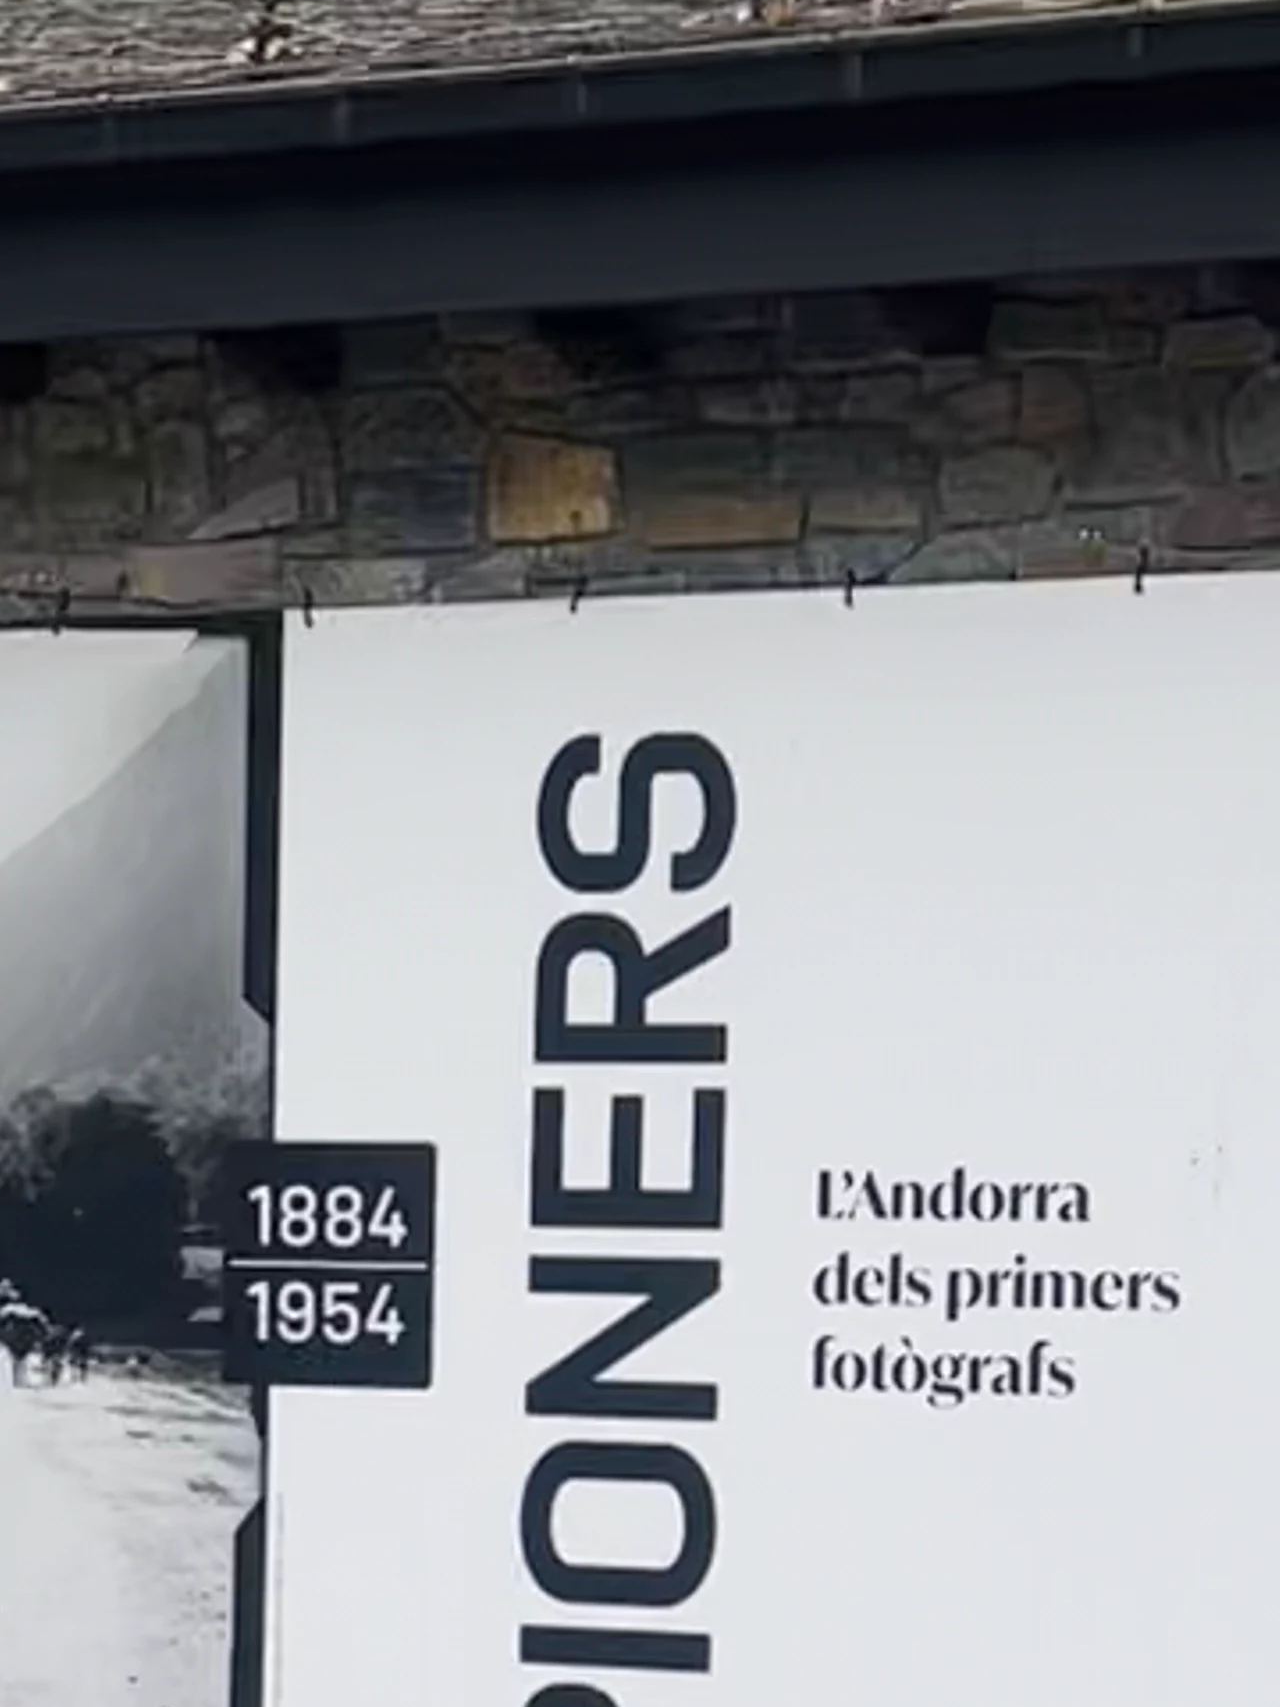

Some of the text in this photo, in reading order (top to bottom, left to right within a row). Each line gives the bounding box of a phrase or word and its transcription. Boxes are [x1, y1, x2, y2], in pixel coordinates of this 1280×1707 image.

[249, 1185, 407, 1247] 1884
[819, 1168, 1089, 1222] L'Andorra
[247, 1281, 404, 1344] 1954
[814, 1252, 1179, 1321] dels primers
[814, 1335, 1074, 1406] fotògrafs
